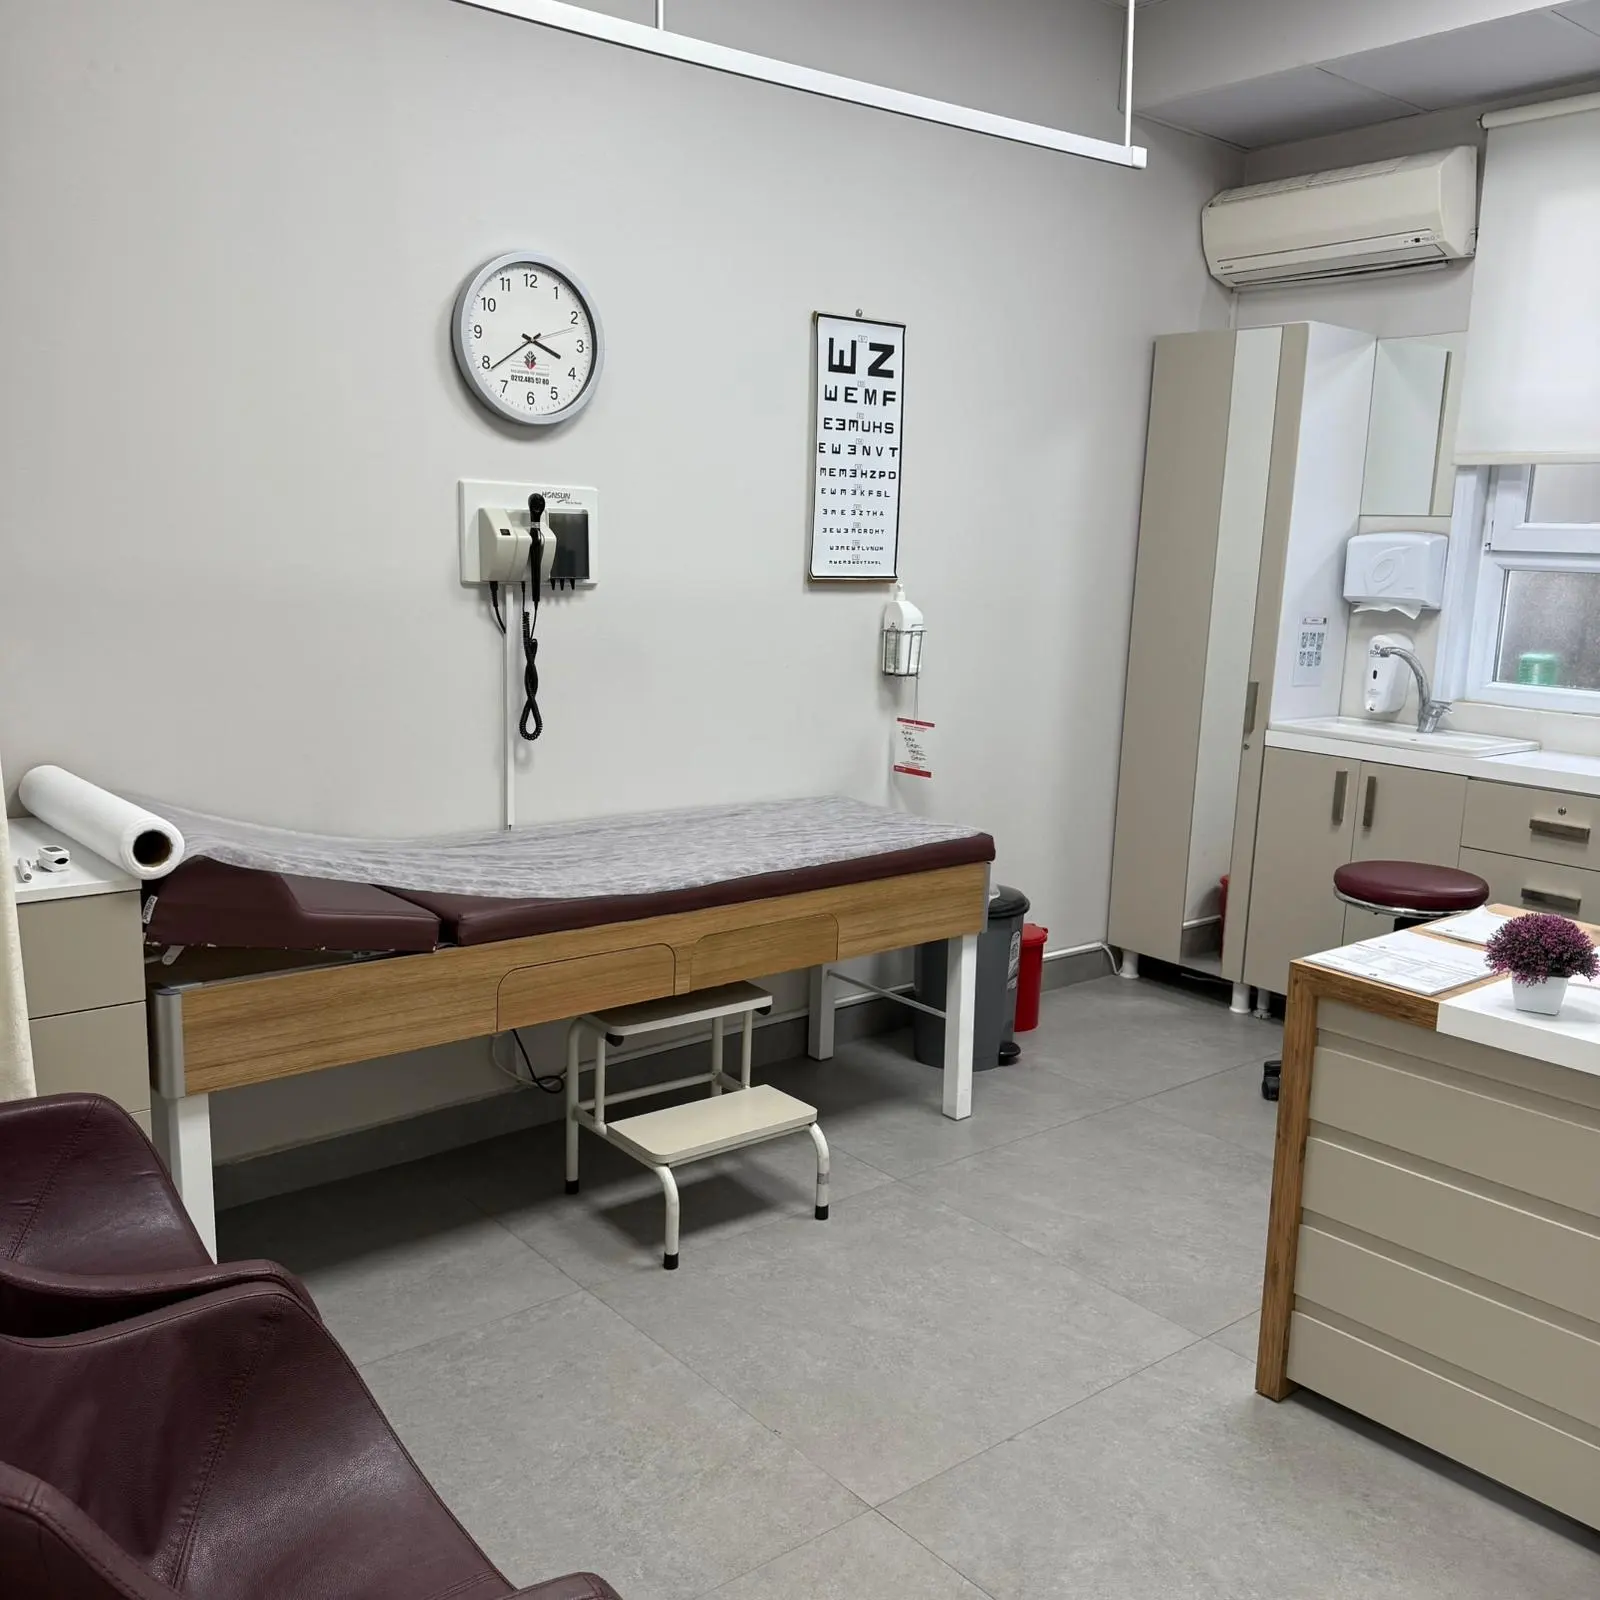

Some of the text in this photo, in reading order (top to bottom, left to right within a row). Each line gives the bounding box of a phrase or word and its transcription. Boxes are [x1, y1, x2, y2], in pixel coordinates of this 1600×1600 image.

[499, 277, 511, 292] 11
[523, 273, 538, 288] 12
[553, 286, 559, 300] 1
[480, 296, 496, 312] 10
[570, 310, 579, 325] 2
[473, 324, 483, 339] 9
[576, 339, 584, 353] 3
[482, 355, 491, 370] 8
[567, 366, 576, 380] 4
[500, 379, 509, 393] 7
[550, 386, 558, 400] 5
[526, 391, 535, 405] 6
